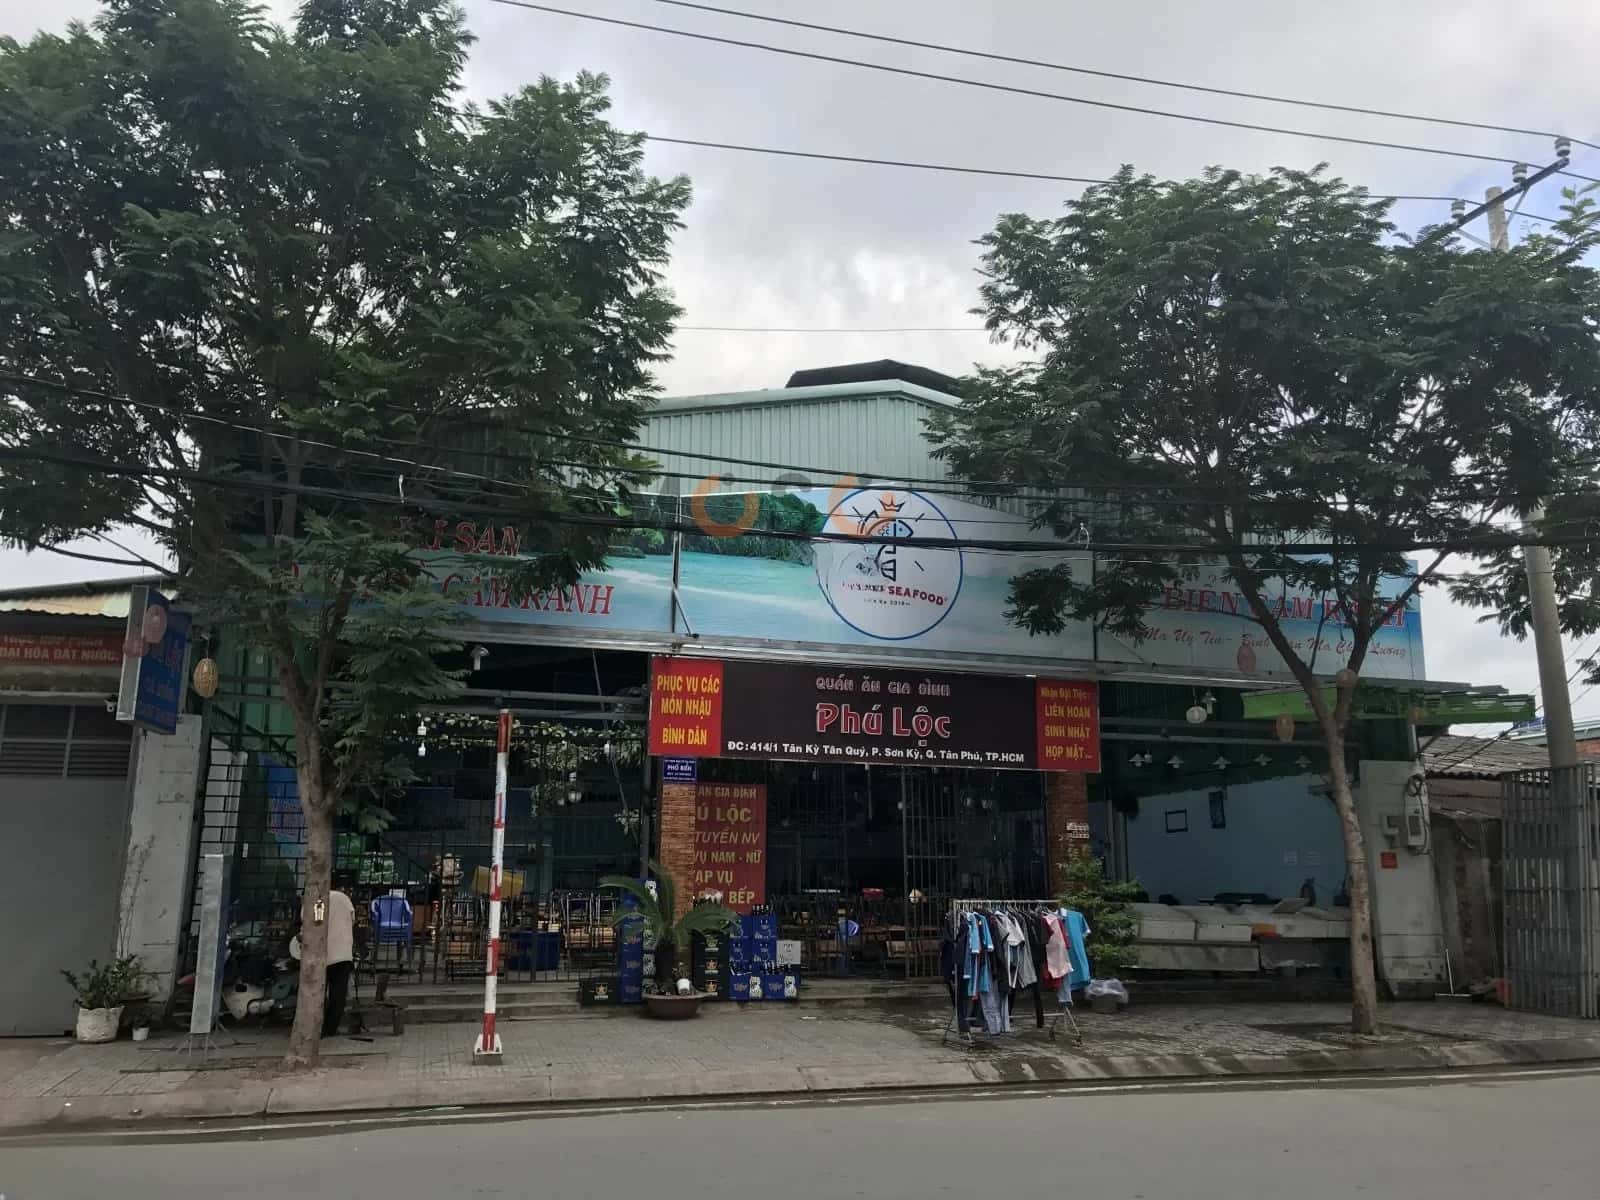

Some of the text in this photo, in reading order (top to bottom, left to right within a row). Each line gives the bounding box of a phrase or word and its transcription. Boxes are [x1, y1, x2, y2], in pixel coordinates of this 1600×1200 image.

[887, 585, 944, 605] SEAFOOD
[657, 675, 683, 695] PHỤC
[701, 674, 720, 693] CÁC
[686, 696, 711, 719] NHẬU
[816, 702, 883, 736] Phú
[662, 723, 708, 746] BÌNH DÂN
[1044, 725, 1065, 737] SINH
[782, 743, 803, 753] Tân
[823, 745, 842, 755] Tân
[872, 747, 882, 756] P.
[885, 747, 904, 758] Sơn
[939, 750, 959, 760] Tân
[985, 752, 1025, 763] TP.HCM
[715, 787, 730, 798] GIA
[716, 803, 752, 825] LỘC
[741, 832, 760, 844] NV
[711, 851, 736, 863] NAM
[745, 850, 762, 864] NỮ
[695, 870, 733, 887] ẠP VỤ
[728, 885, 755, 904] BẾP
